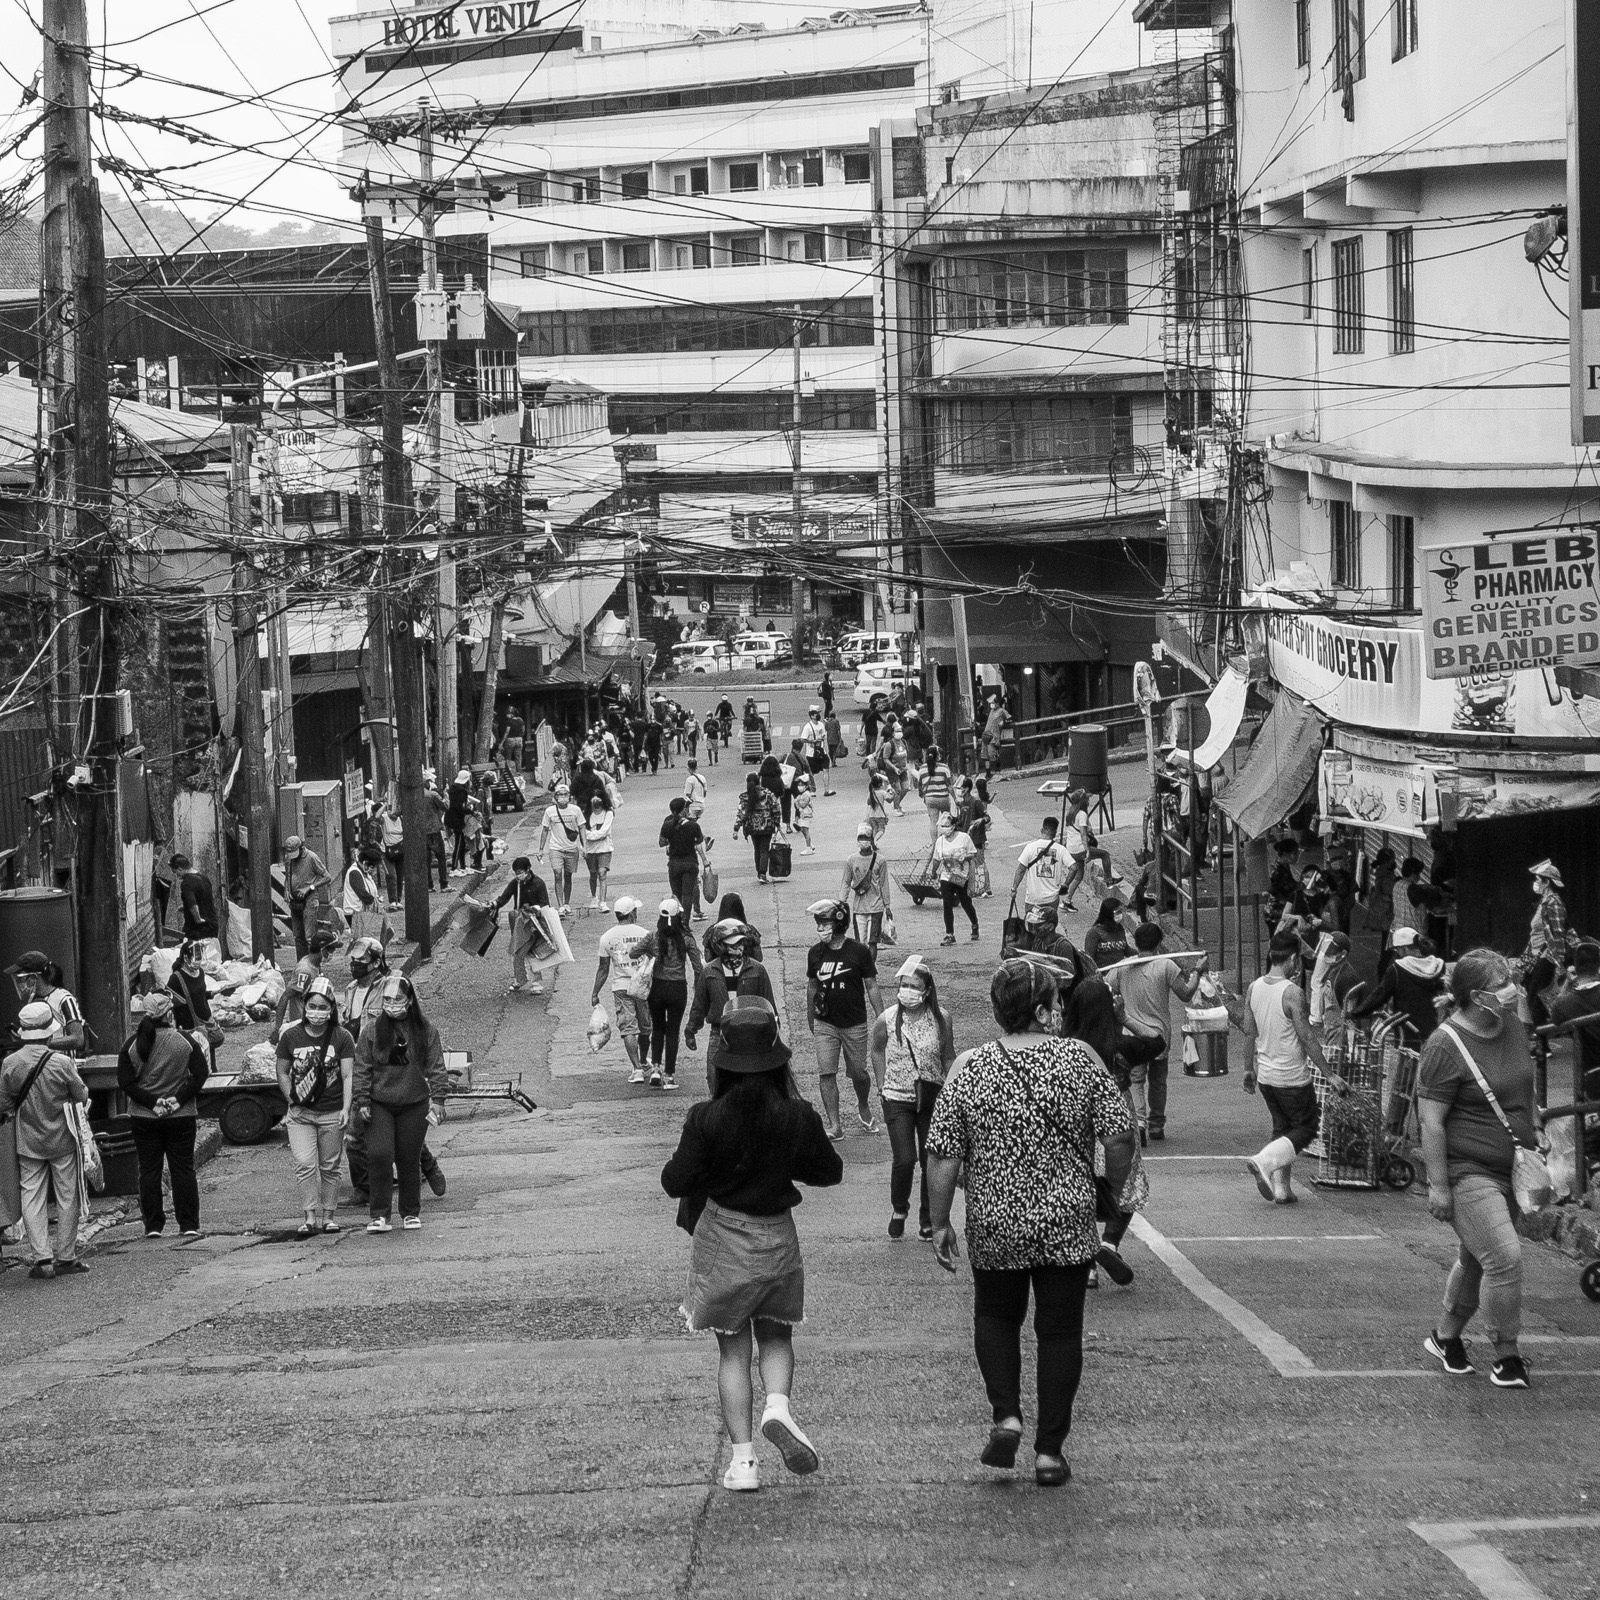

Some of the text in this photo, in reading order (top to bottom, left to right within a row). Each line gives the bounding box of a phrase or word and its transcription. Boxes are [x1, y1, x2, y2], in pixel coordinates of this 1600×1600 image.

[382, 1, 542, 46] HOTEL VENIZ
[1474, 536, 1596, 571] LEB
[1474, 562, 1595, 600] PHARMACY
[1432, 601, 1598, 639] GENERICS
[1470, 595, 1558, 612] QUALITY
[1295, 618, 1315, 662] SPOT
[1316, 626, 1398, 684] GROCERY
[1433, 631, 1599, 669] BRANDED
[1500, 629, 1534, 639] AND
[1469, 655, 1565, 674] MEDICINE
[1502, 776, 1538, 785] FOREVER
